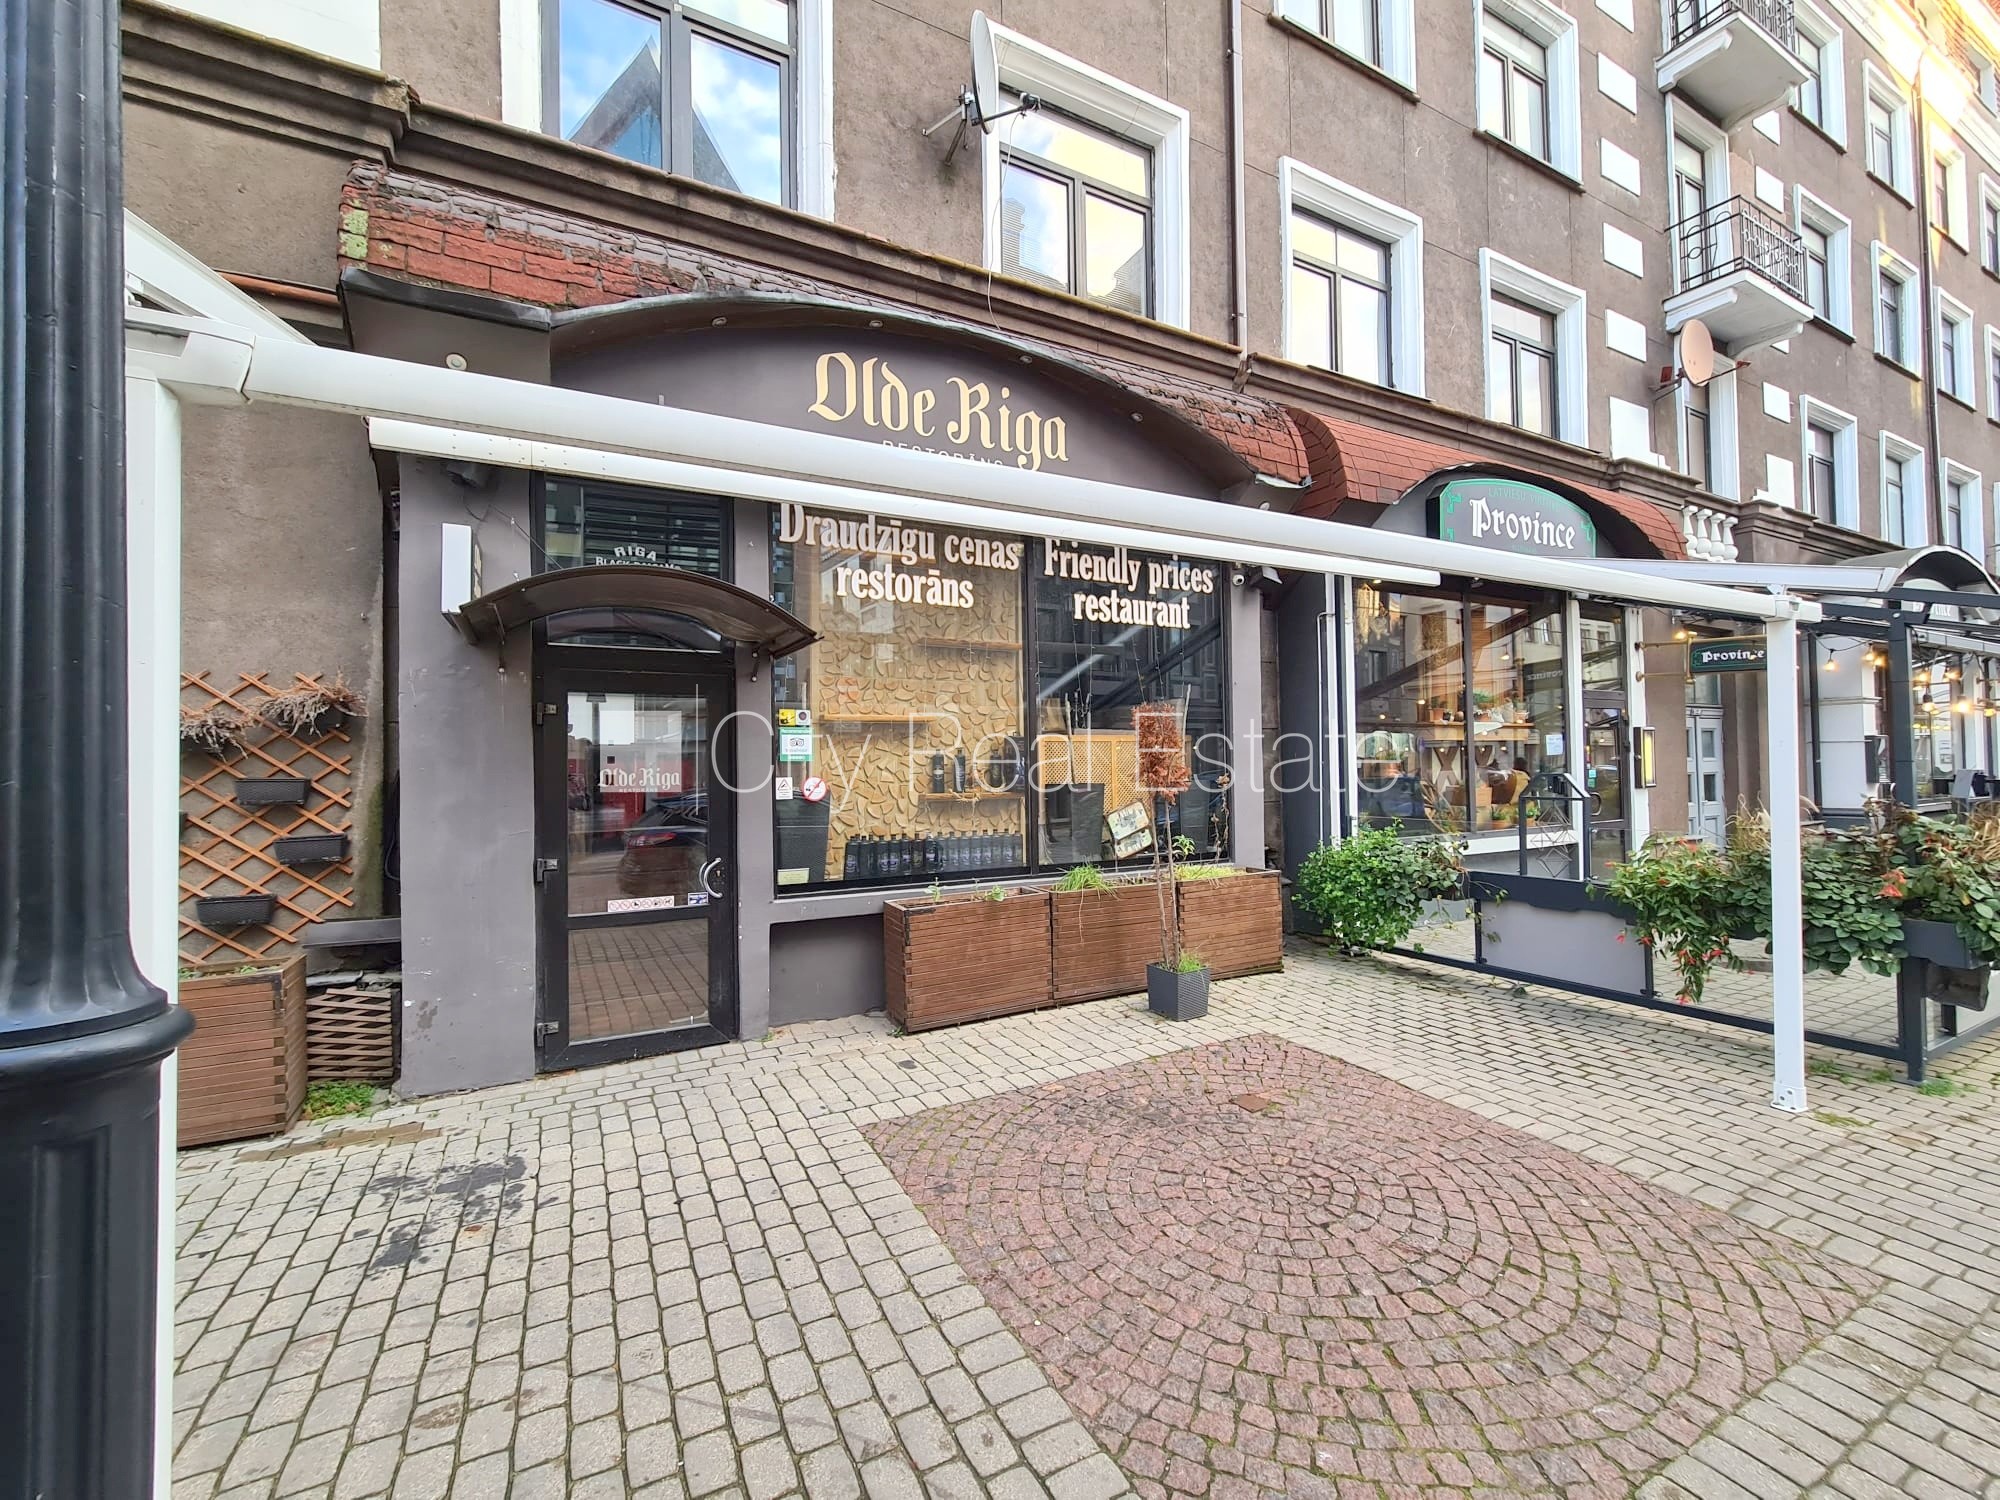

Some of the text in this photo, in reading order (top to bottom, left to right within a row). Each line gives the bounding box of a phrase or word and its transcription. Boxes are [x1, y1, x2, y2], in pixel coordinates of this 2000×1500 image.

[807, 351, 1069, 472] Olde Riga
[779, 502, 1020, 571] Draudzīgu cenas
[1469, 496, 1576, 550] Province
[613, 545, 657, 562] RIGA
[1044, 537, 1214, 594] Friendly prices
[836, 563, 974, 609] restorāns
[1073, 589, 1191, 629] restaurant
[639, 767, 681, 789] Riga
